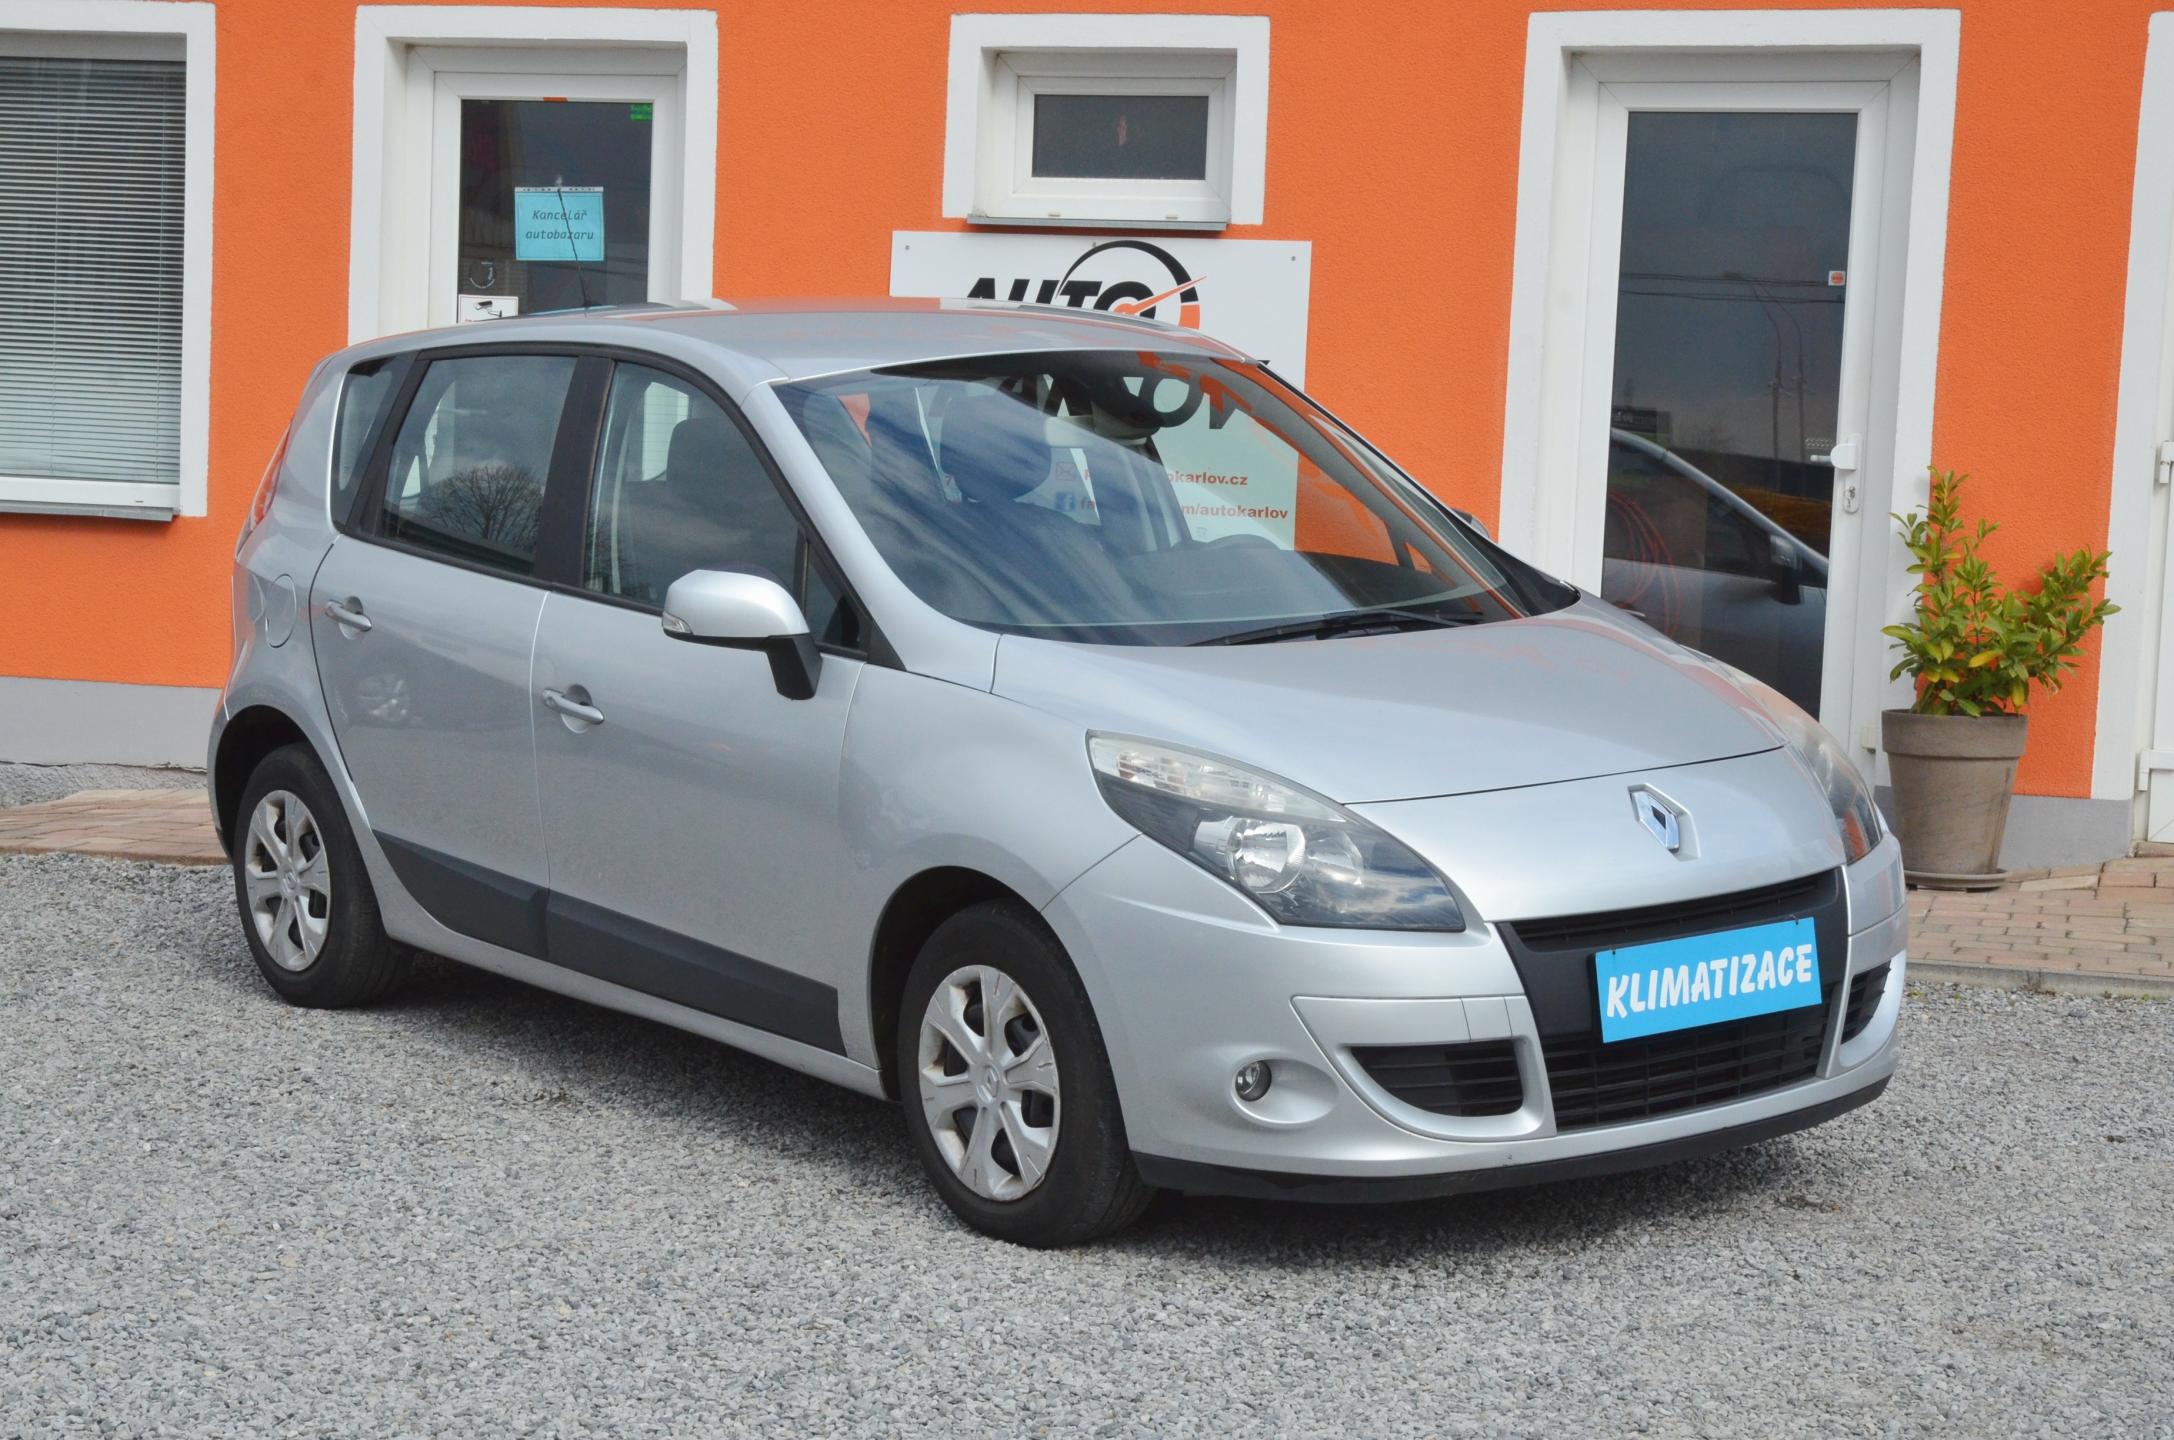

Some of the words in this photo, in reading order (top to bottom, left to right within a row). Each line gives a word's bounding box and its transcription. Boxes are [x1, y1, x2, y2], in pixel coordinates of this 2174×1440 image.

[532, 209, 588, 221] Kancelář
[525, 229, 594, 240] autobazaru
[1166, 470, 1248, 486] okarlov.cz
[1181, 503, 1289, 519] m/autokarlov
[1606, 943, 1813, 1018] KLIMATIZACE
